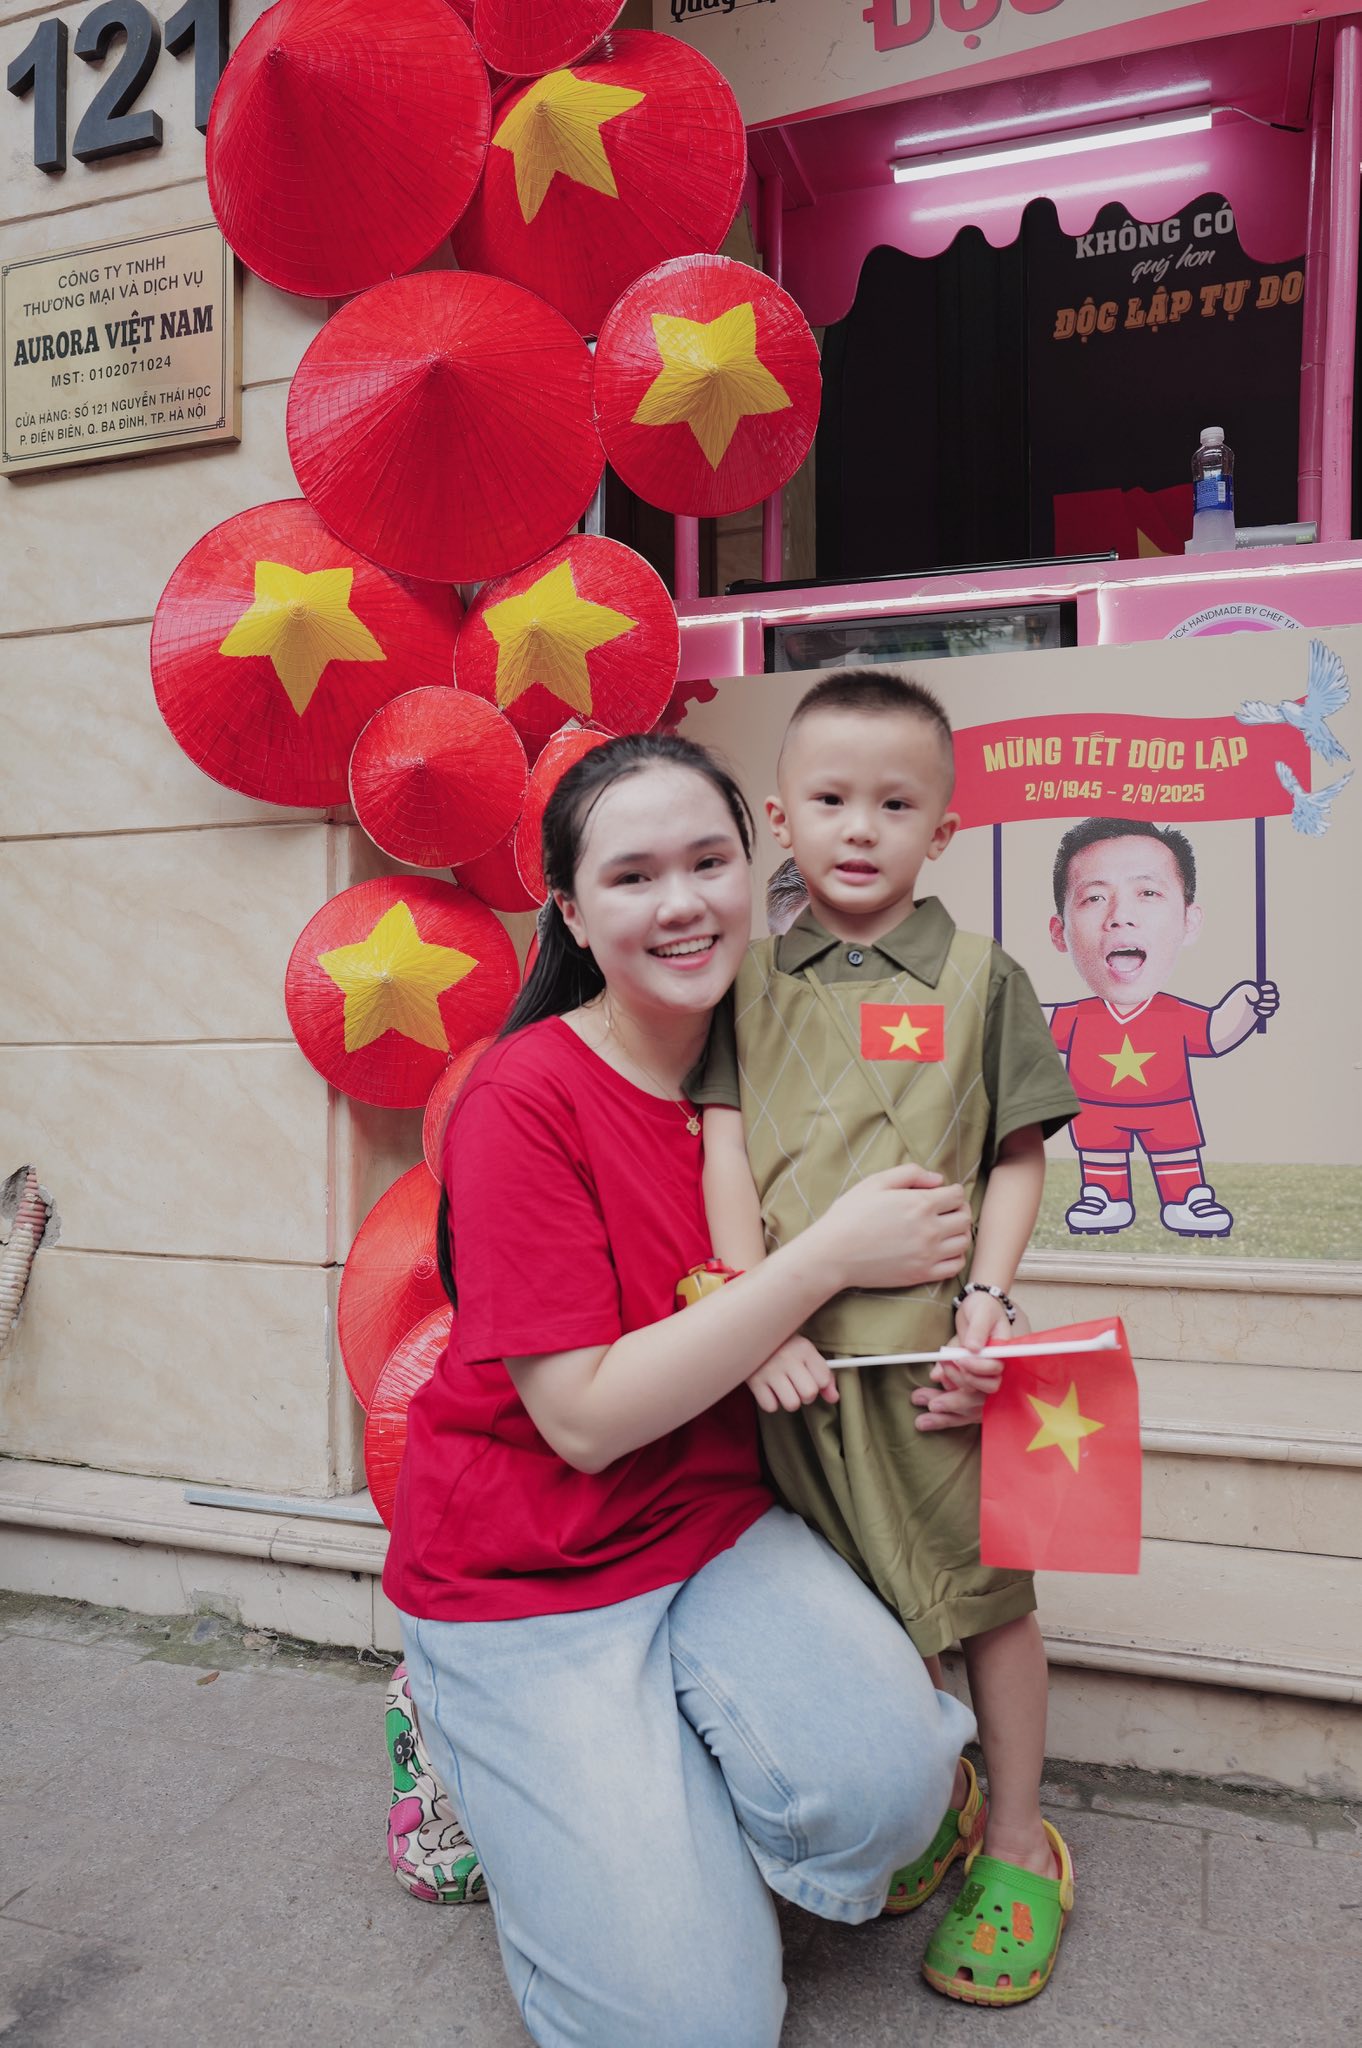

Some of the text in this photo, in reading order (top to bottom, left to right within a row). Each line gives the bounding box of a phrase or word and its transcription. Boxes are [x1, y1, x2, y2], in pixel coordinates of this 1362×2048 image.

[7, 0, 230, 173] 121
[1075, 202, 1234, 259] KHÔNG CÓ
[58, 256, 166, 289] CÔNG TY TNHH
[1131, 253, 1174, 284] quý
[23, 270, 204, 317] THƯƠNG MẠI VÀ DỊCH VỤ
[1053, 270, 1305, 343] ĐỘC LẬP TỰ DO
[13, 304, 214, 367] AURORA VIỆT NAM
[51, 355, 172, 388] MST: 0102071024
[15, 385, 211, 428] CỬA HÀNG: SỐ 121 NGUYỄN THÁI HỌC
[20, 435, 28, 446] P.
[30, 428, 54, 444] ĐIỆN
[87, 423, 98, 436] Q.
[101, 421, 115, 432] BA
[150, 412, 166, 424] TP.
[169, 406, 184, 421] HÀ
[187, 403, 206, 419] NỘI
[1188, 606, 1242, 628] HANDMADE
[1244, 605, 1258, 615] BY
[1259, 608, 1284, 622] CHEF
[1284, 618, 1300, 629] TA
[983, 730, 1248, 773] MỪNG TẾT ĐỘC LẬP
[1024, 780, 1103, 802] 2/9/1945
[1121, 783, 1205, 804] 2/9/2025
